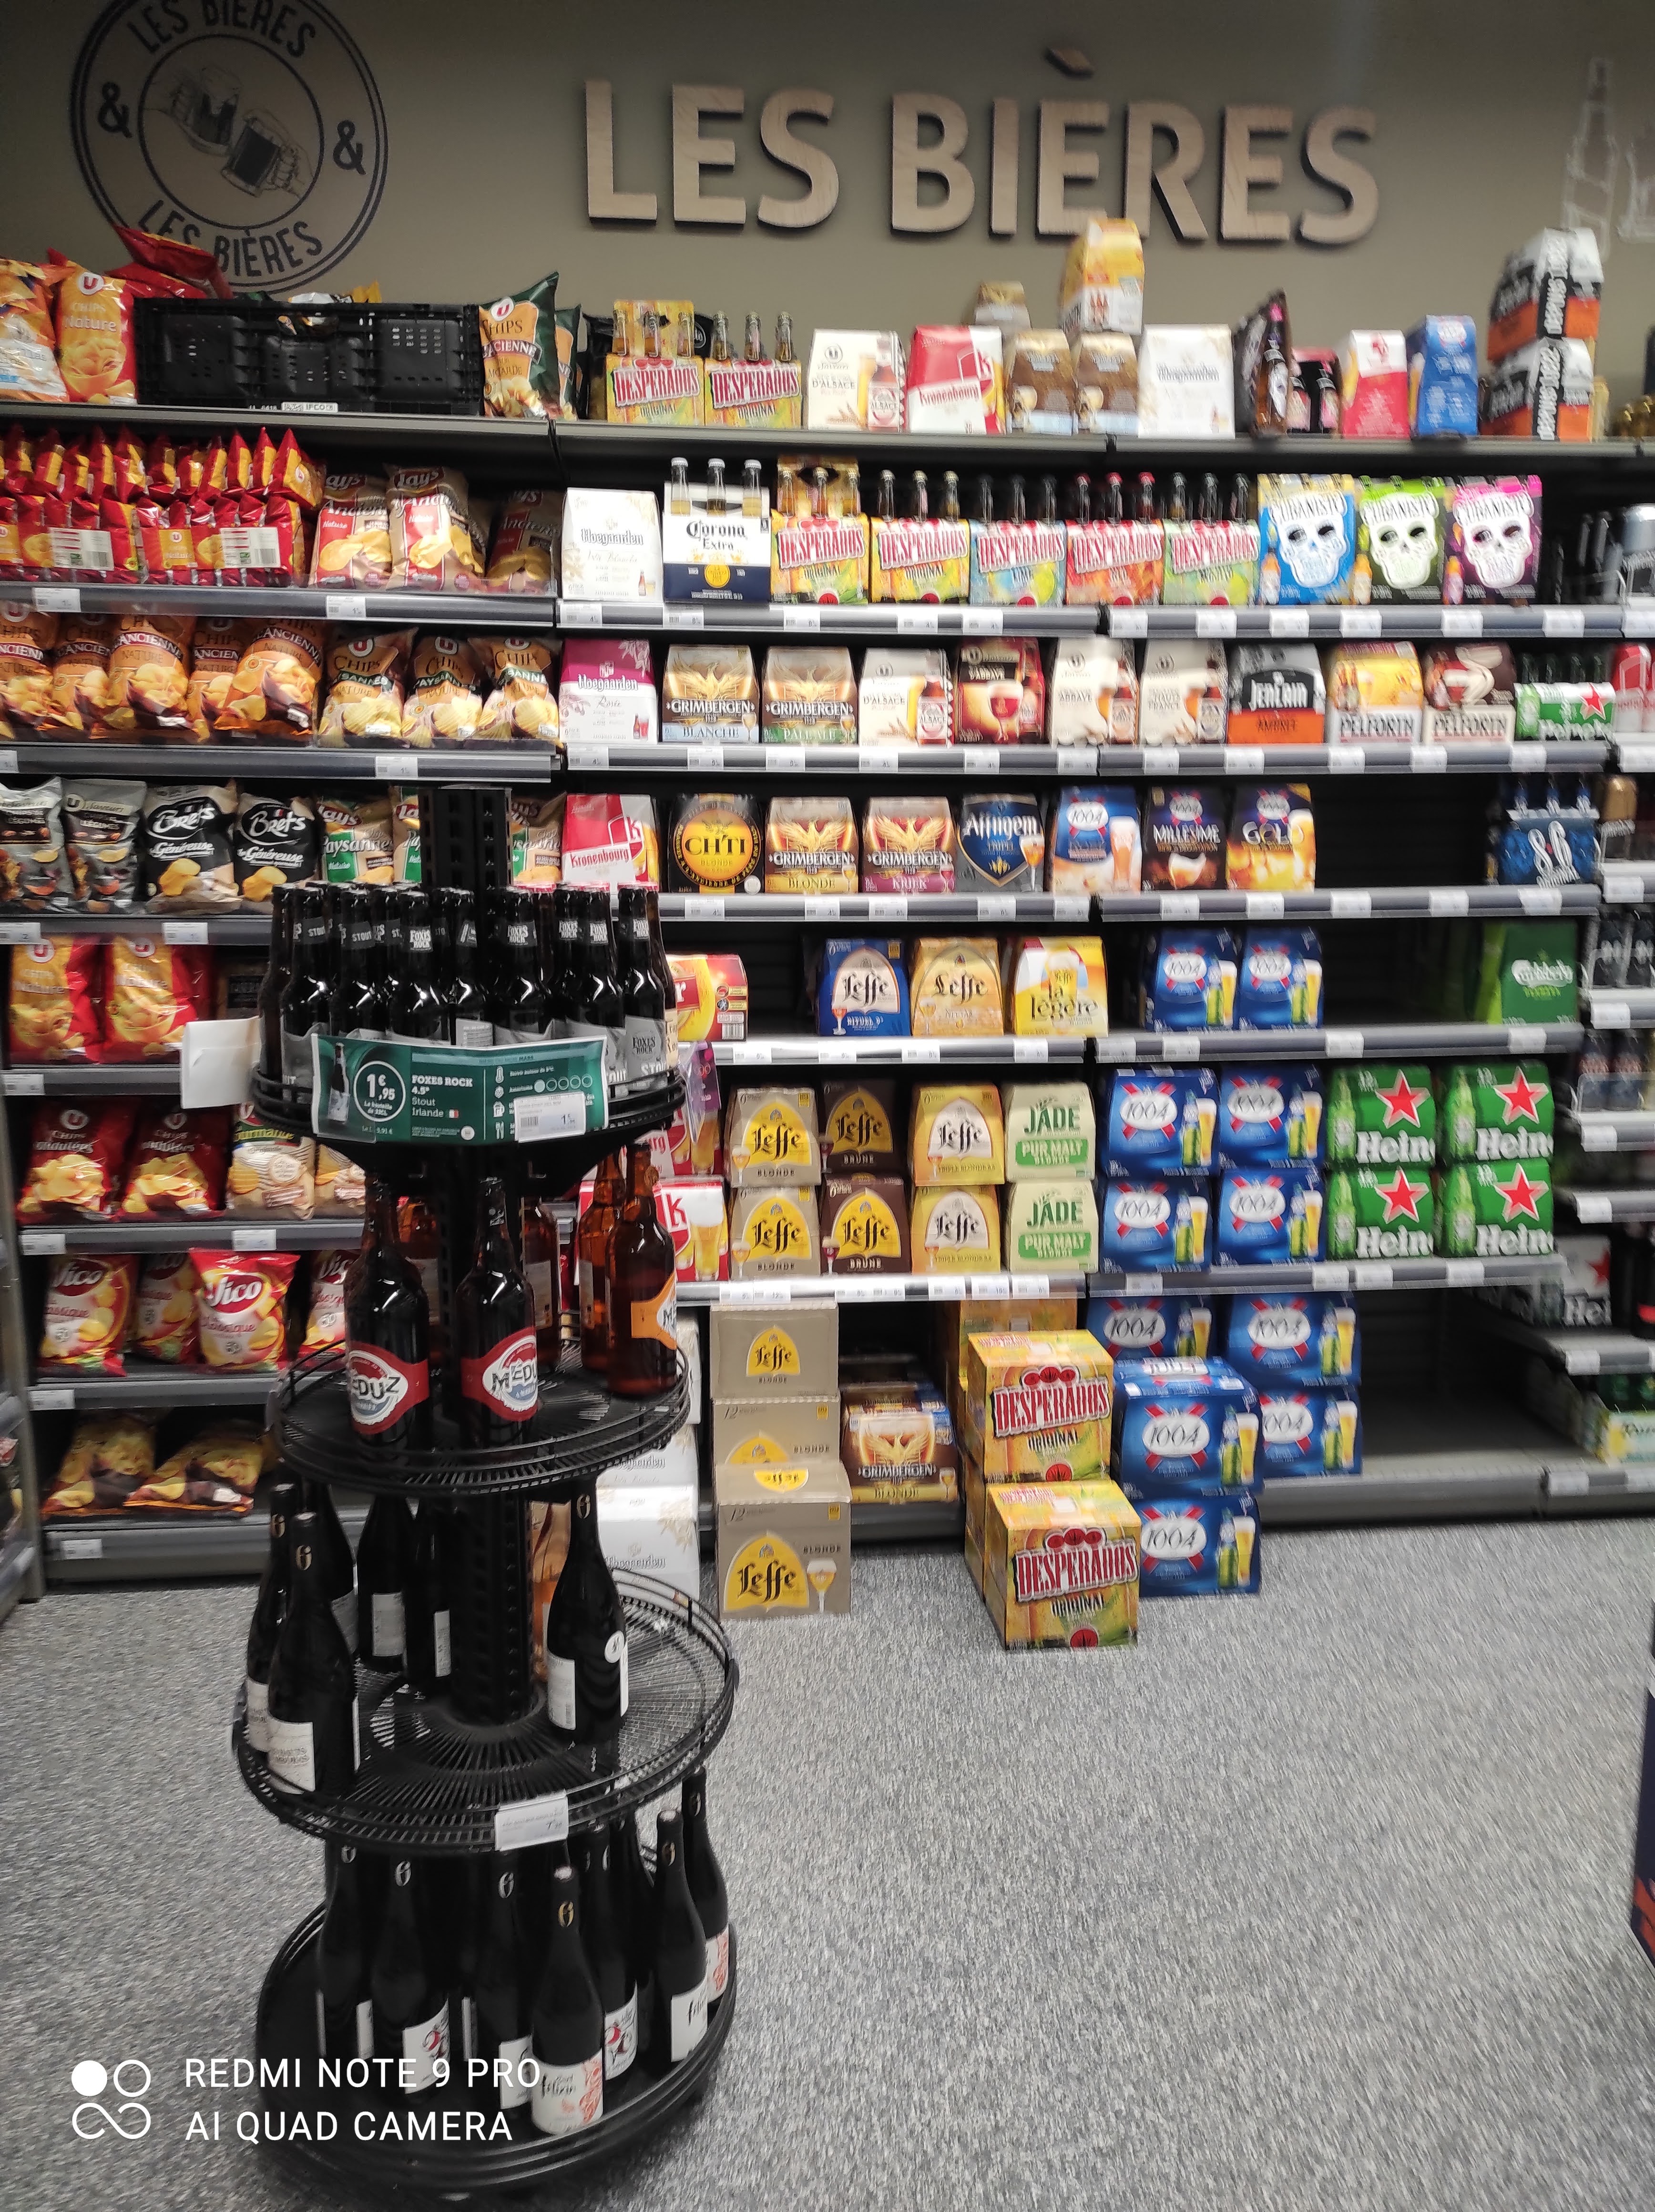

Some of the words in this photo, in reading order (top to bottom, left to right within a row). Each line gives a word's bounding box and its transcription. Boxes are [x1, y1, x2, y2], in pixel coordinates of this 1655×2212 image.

[98, 82, 132, 138] &
[333, 120, 366, 175] &
[585, 80, 840, 227] LES
[891, 49, 1379, 243] BIÈRES
[215, 221, 323, 276] BIÈRES
[66, 316, 117, 331] Nature
[614, 366, 700, 407] DESPERADOS
[712, 368, 799, 409] DESPERADOS
[812, 379, 855, 390] D'ALSACE
[917, 382, 981, 406] Kronenbourg
[323, 521, 347, 529] Nature
[686, 521, 746, 541] Corona
[703, 538, 734, 550] Extra
[778, 529, 865, 569] DESPERADOS
[879, 528, 968, 570] DESPERADOS
[977, 532, 1065, 573] DESPERADOS
[1073, 530, 1162, 573] DESPERADOS
[1171, 530, 1259, 573] DESPERADOS
[122, 650, 163, 663] NATURE
[334, 656, 383, 673] CHIPS
[578, 674, 638, 691] Hoegaarden
[671, 699, 751, 714] GRIMBERGEN
[771, 701, 848, 716] GRIMBERGEN
[863, 697, 905, 706] D'ALSACE
[682, 727, 739, 738] BLANCHE
[1242, 821, 1304, 845] GOLD
[571, 847, 630, 868] Kronenbourg
[775, 852, 851, 865] GRIMBERGEN
[873, 851, 949, 867] GRIMBERGEN
[788, 878, 836, 889] BLONDE
[843, 971, 889, 1008] Leffe
[933, 971, 988, 1005] Leffe
[633, 1036, 656, 1048] FOXES
[636, 1046, 653, 1055] ROCK
[411, 1075, 443, 1086] FOXES
[444, 1077, 473, 1088] ROCK
[411, 1096, 436, 1106] Stout
[411, 1107, 444, 1118] Irlande
[835, 1111, 883, 1147] Leffe
[937, 1119, 983, 1154] Leffe
[752, 1122, 801, 1162] Leffe
[1022, 1139, 1048, 1157] PUR
[1051, 1138, 1083, 1156] MALT
[844, 1153, 875, 1165] BRUNE
[757, 1168, 795, 1178] BLONDE
[669, 1194, 688, 1228] K
[752, 1216, 801, 1254] Leffe
[842, 1214, 891, 1252] Leffe
[934, 1211, 981, 1249] Leffe
[1025, 1235, 1052, 1251] PUR
[1053, 1233, 1085, 1250] MALT
[757, 1262, 795, 1271] BLONDE
[849, 1258, 882, 1269] BRUNE
[206, 1277, 262, 1307] Vico
[755, 1343, 792, 1371] Leffe
[758, 1376, 787, 1384] BLONDE
[724, 1406, 738, 1420] 12
[991, 1377, 1110, 1438] DESPERADOS
[793, 1444, 830, 1454] BLONDE
[860, 1464, 933, 1478] GRIMBERGEN
[874, 1486, 919, 1500] BLONDE
[729, 1507, 745, 1523] 12
[804, 1545, 841, 1554] BLONDE
[1012, 1538, 1139, 1602] DESPERADOS
[737, 1559, 797, 1602] Leffe
